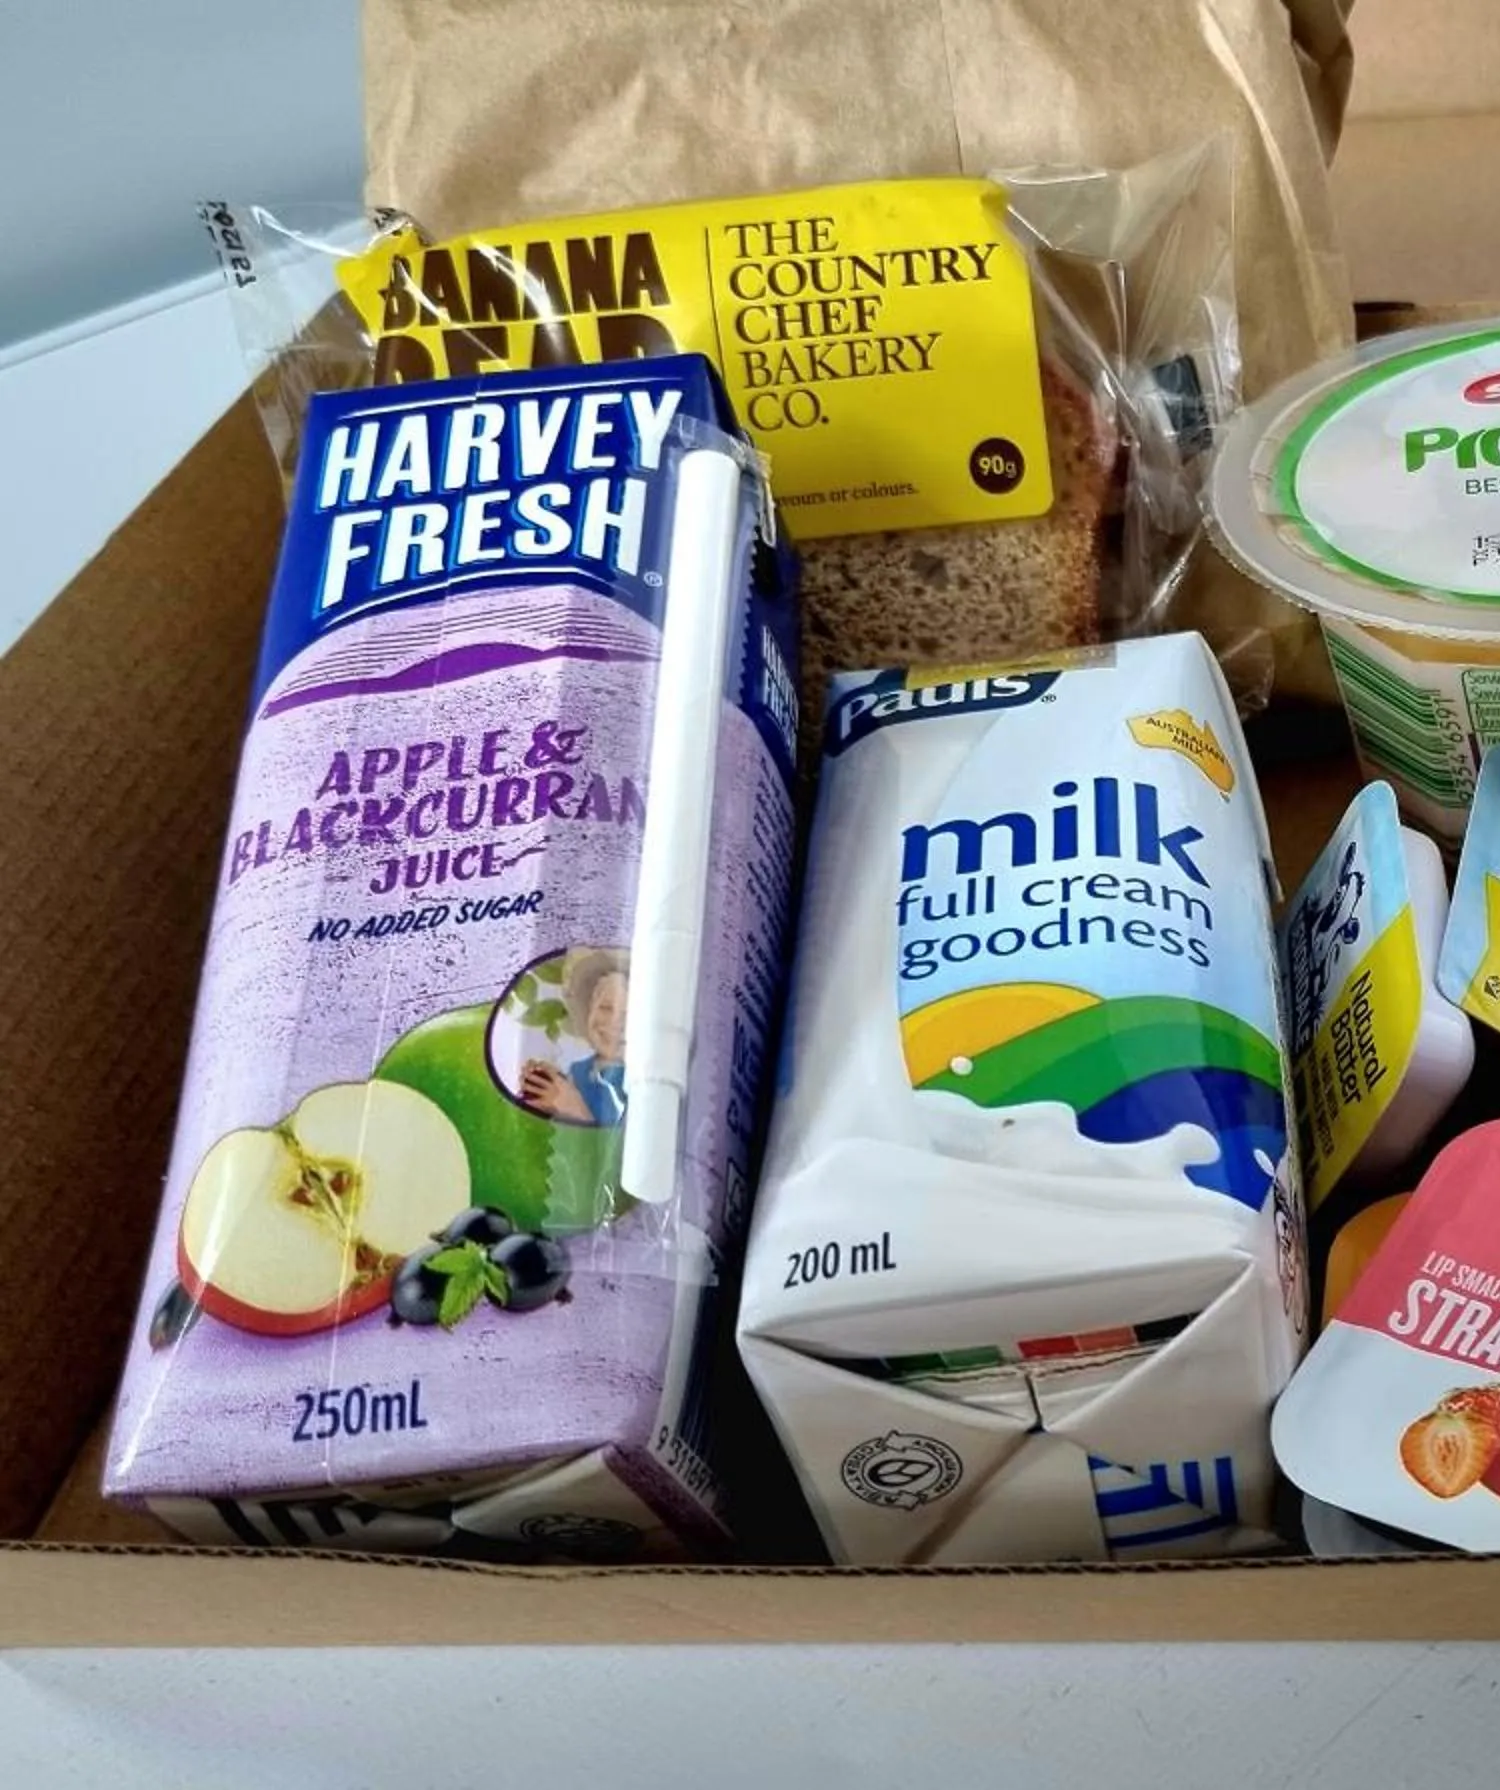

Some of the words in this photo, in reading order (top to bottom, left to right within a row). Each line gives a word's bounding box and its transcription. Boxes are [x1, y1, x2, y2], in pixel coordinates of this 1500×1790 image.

[725, 217, 838, 259] THE
[380, 232, 671, 331] BANANA
[729, 243, 999, 300] COUNTRY
[735, 296, 883, 345] CHEF
[741, 332, 943, 389] BAKERY
[748, 389, 829, 432] CO.
[318, 390, 683, 510] HARVEY
[979, 456, 1017, 479] 90g
[830, 488, 848, 502] or
[316, 478, 648, 613] FRESH
[316, 728, 511, 800] APPLE
[524, 720, 589, 768] &
[229, 770, 648, 887] BLACKCURRAN
[901, 777, 1211, 888] milk
[368, 840, 505, 896] JUICE
[308, 917, 357, 944] NO
[356, 903, 451, 940] ADDED
[454, 890, 544, 924] SUGAR
[897, 875, 996, 927] full
[1021, 873, 1213, 931] cream
[901, 907, 1211, 981] goodness
[1331, 1009, 1361, 1104] Butter
[1350, 969, 1387, 1092] Natural
[784, 1241, 840, 1289] 200
[851, 1231, 897, 1275] mL
[1421, 1251, 1453, 1279] LIP
[292, 1380, 428, 1442] 250mL
